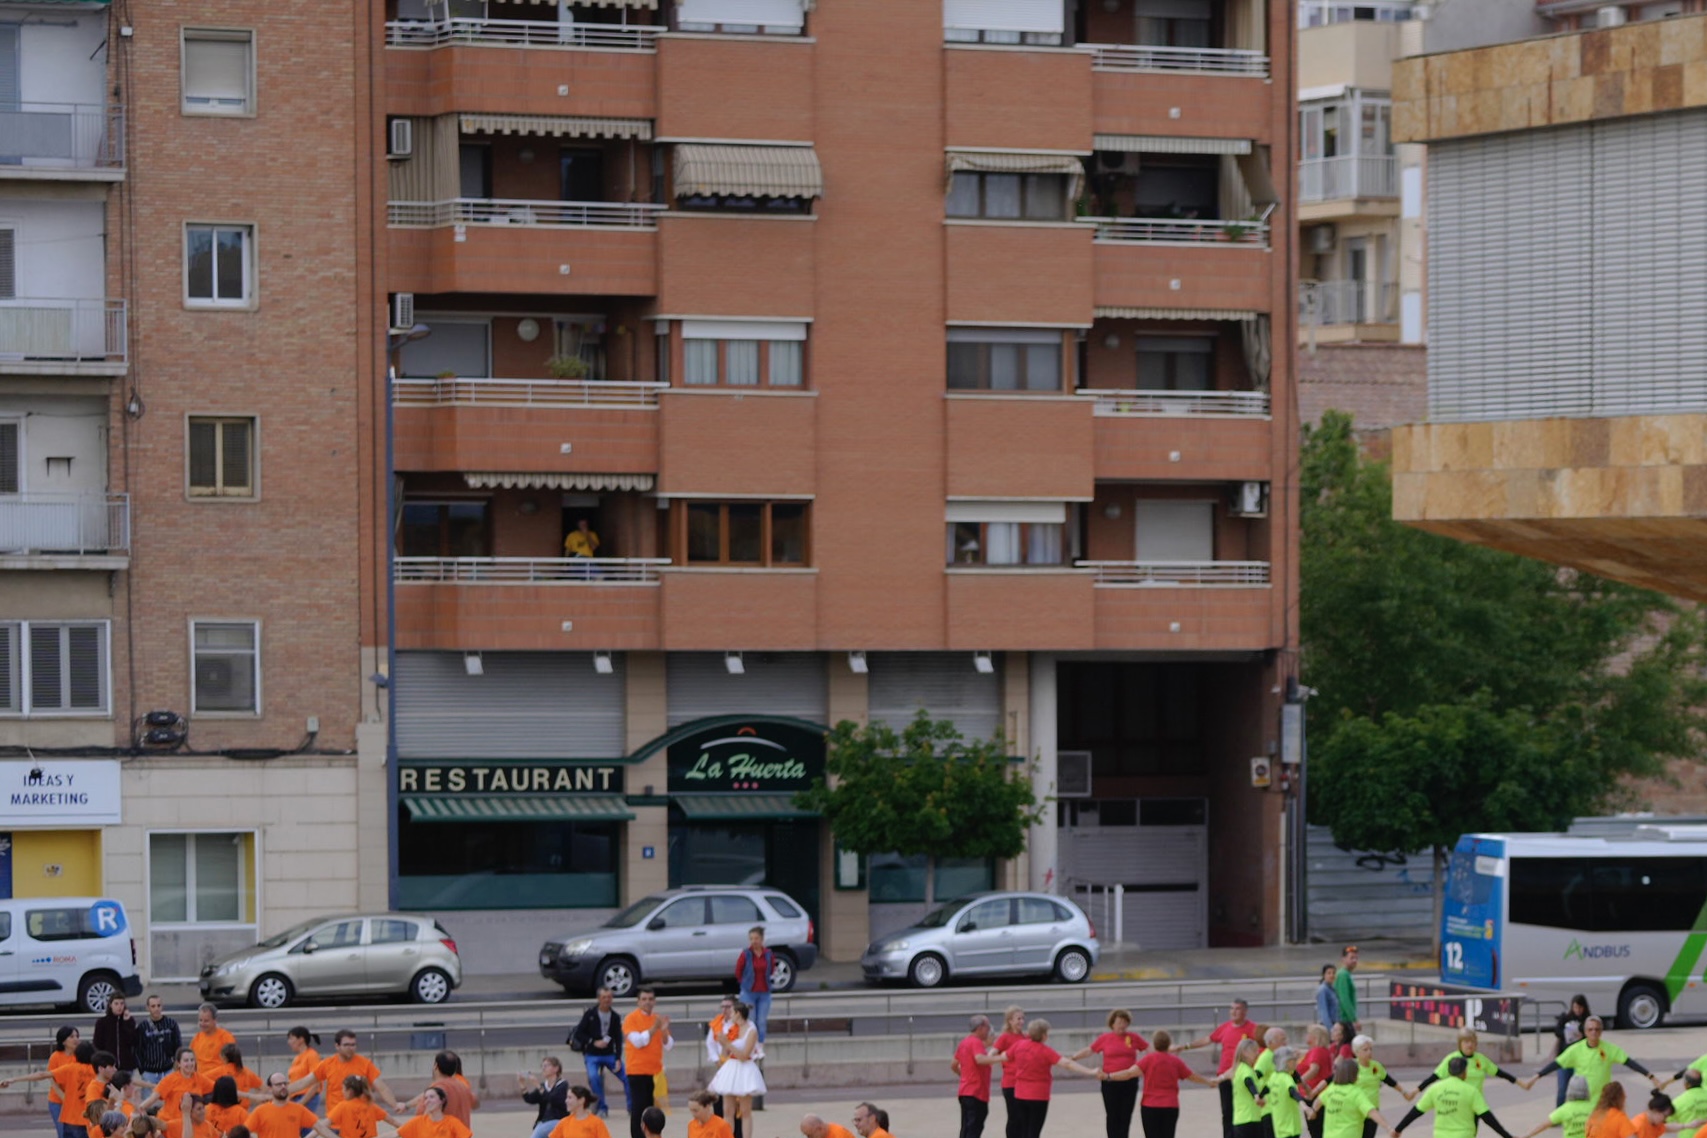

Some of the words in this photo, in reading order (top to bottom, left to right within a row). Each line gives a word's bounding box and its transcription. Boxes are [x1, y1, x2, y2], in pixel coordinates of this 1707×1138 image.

[685, 753, 724, 780] La
[728, 753, 807, 780] Huerta
[66, 774, 75, 787] Y
[400, 768, 615, 792] RESTAURANT
[10, 793, 89, 805] MARKETING
[97, 907, 118, 931] R
[1445, 941, 1464, 971] 12
[1563, 938, 1631, 960] ANDBUS
